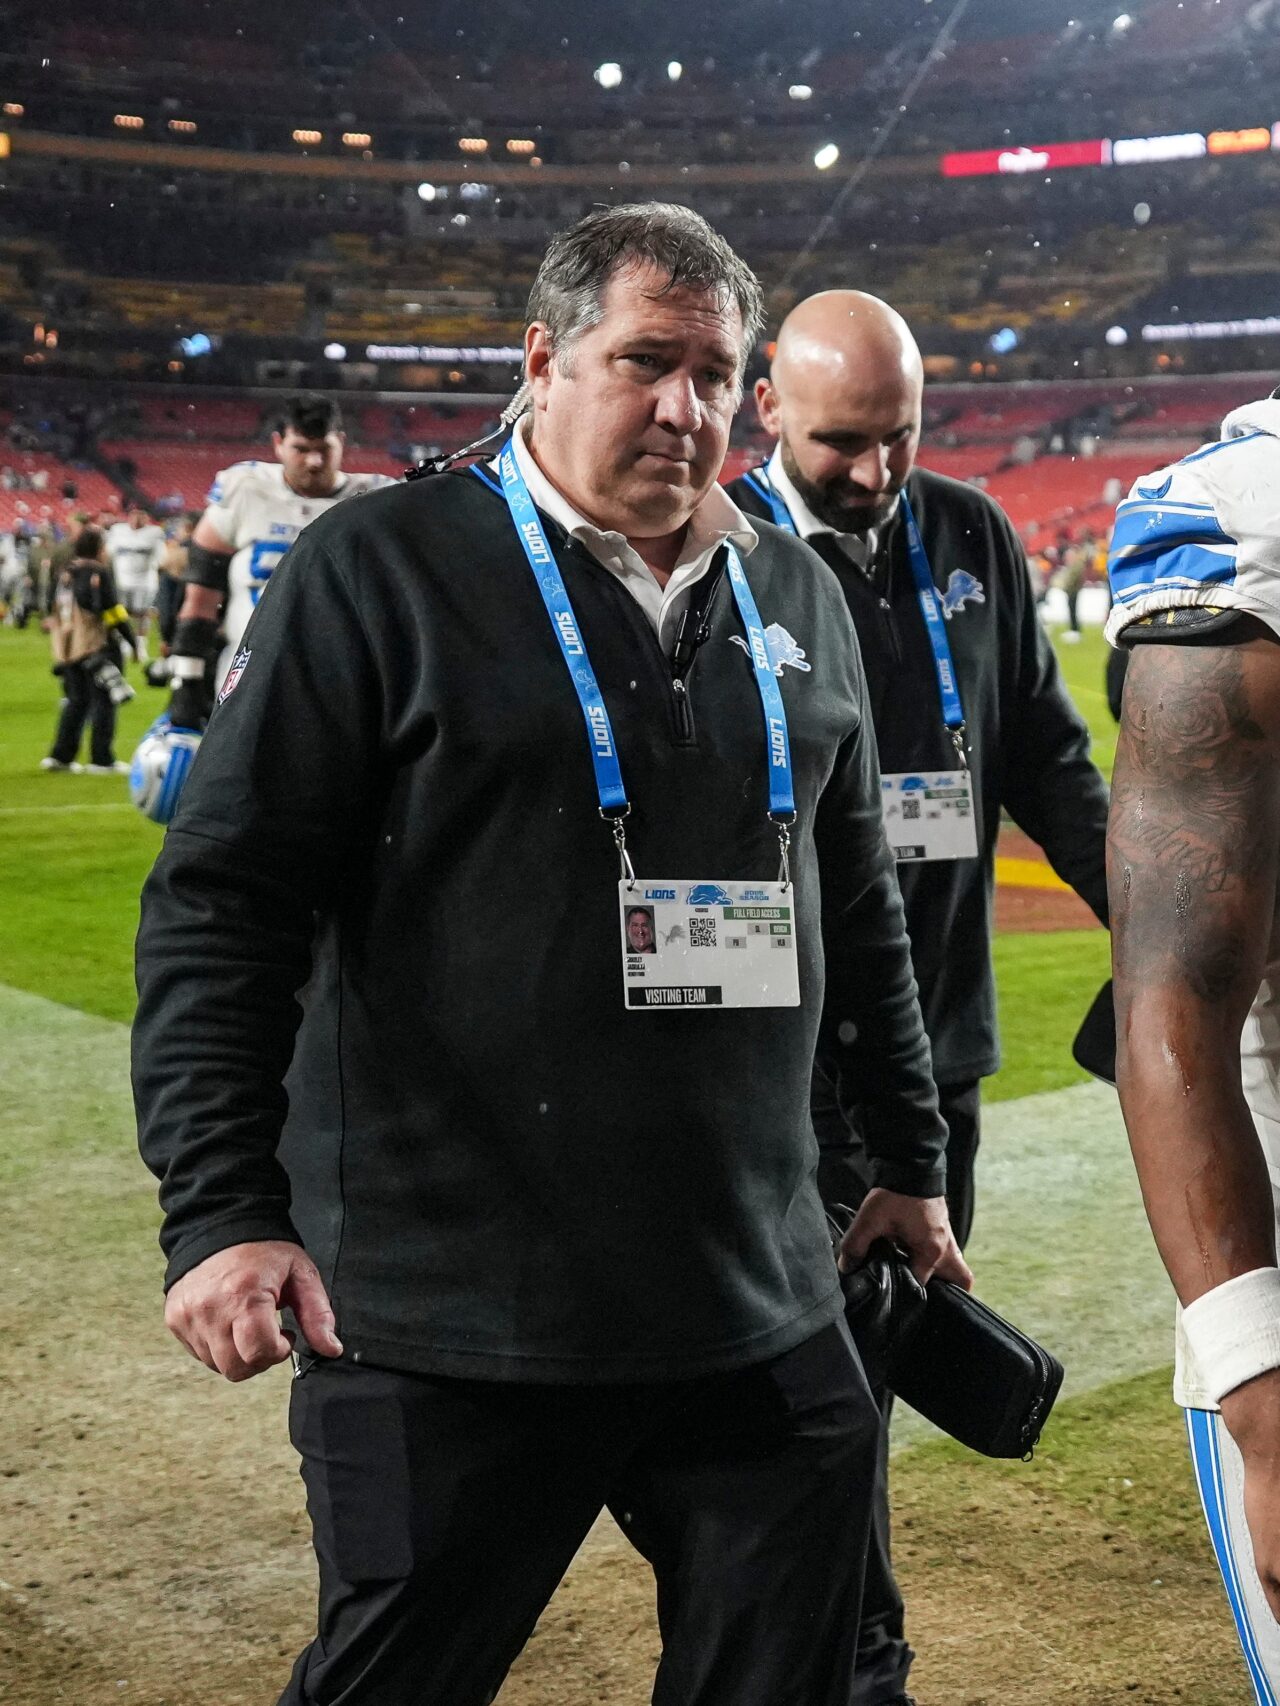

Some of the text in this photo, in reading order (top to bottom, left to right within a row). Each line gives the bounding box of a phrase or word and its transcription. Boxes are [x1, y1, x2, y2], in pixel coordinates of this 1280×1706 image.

[521, 521, 551, 564] LIONS
[554, 611, 584, 655] LIONS
[749, 625, 771, 671] LIONS
[587, 705, 612, 757] LIONS
[769, 717, 787, 768] LIONS
[645, 890, 676, 900] LIONS
[645, 988, 706, 1004] VISITING TEAM
